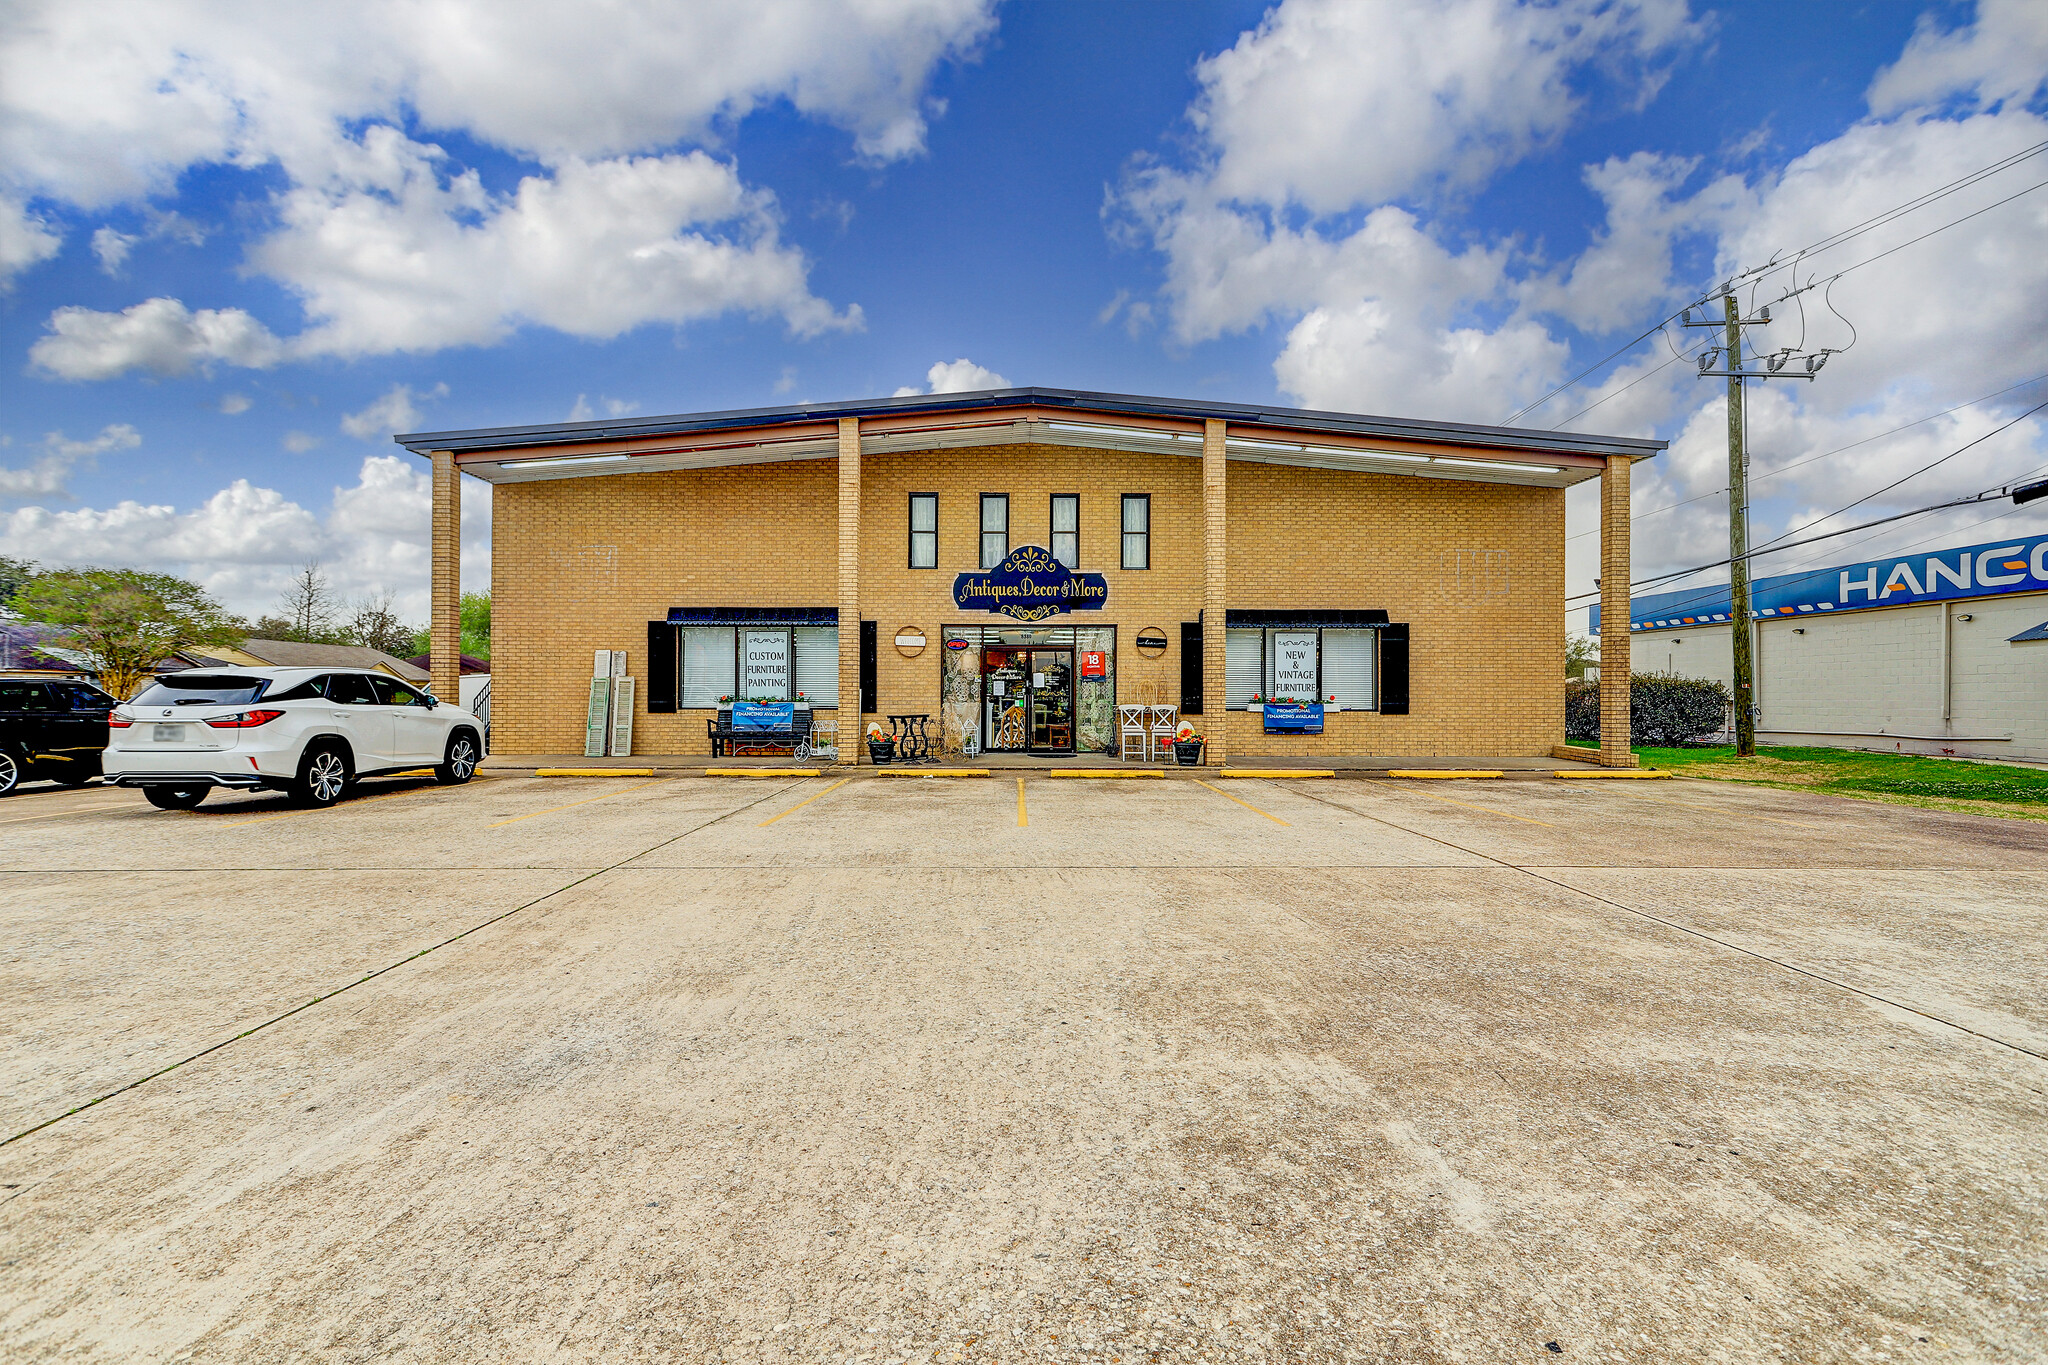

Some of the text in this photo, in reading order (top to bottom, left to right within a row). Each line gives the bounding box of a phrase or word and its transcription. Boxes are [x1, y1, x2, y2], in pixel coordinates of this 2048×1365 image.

[958, 575, 1104, 603] Antiques, Decor & More
[749, 651, 785, 661] CUSTOM
[1087, 654, 1100, 665] 18
[1285, 650, 1306, 660] NEW
[747, 665, 786, 674] FURNITURE
[1292, 660, 1299, 669] &
[1278, 670, 1315, 680] VINTAGE
[748, 678, 786, 687] PAINTING
[1276, 683, 1316, 692] FURNITURE
